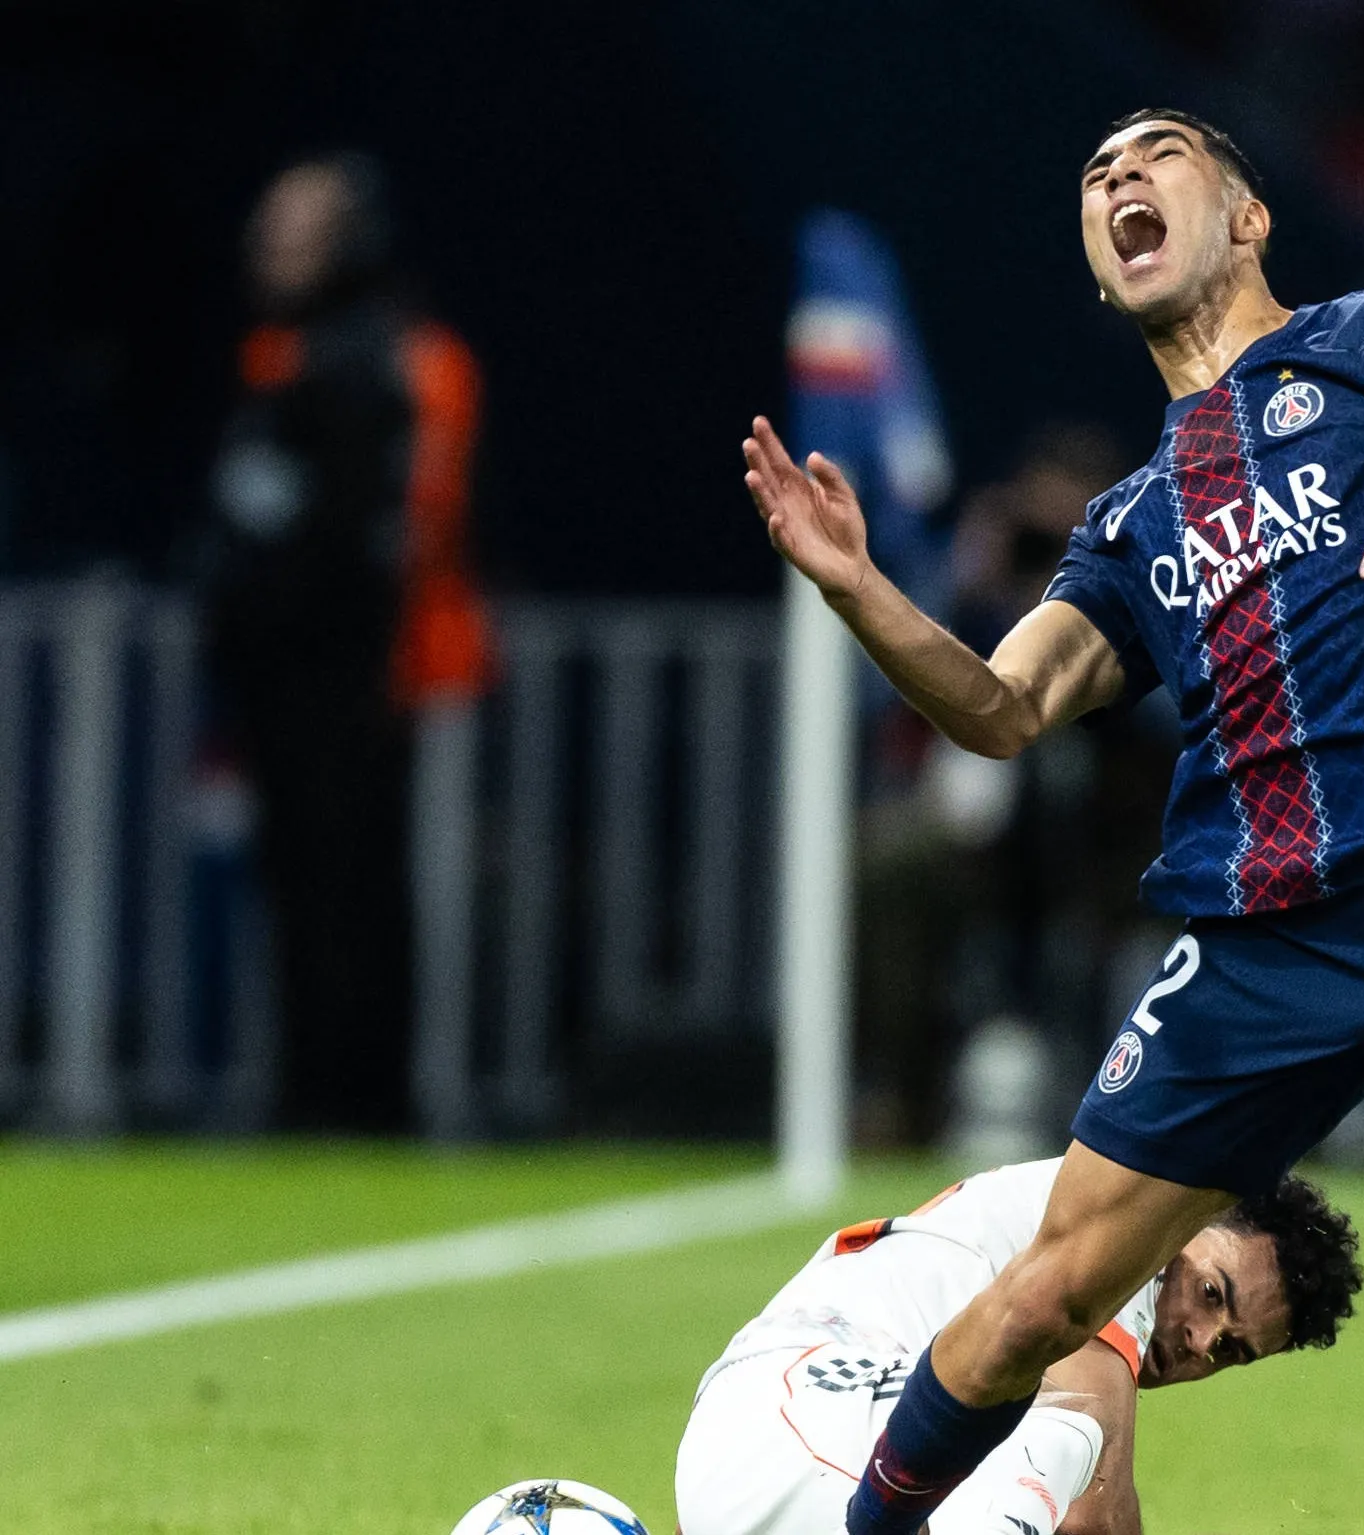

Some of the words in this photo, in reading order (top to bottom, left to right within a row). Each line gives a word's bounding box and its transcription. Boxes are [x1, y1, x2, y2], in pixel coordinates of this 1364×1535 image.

[1269, 386, 1310, 410] PARIS
[1150, 463, 1340, 611] QATAR
[1195, 512, 1347, 618] AIRWAYS
[1131, 933, 1200, 1036] 2
